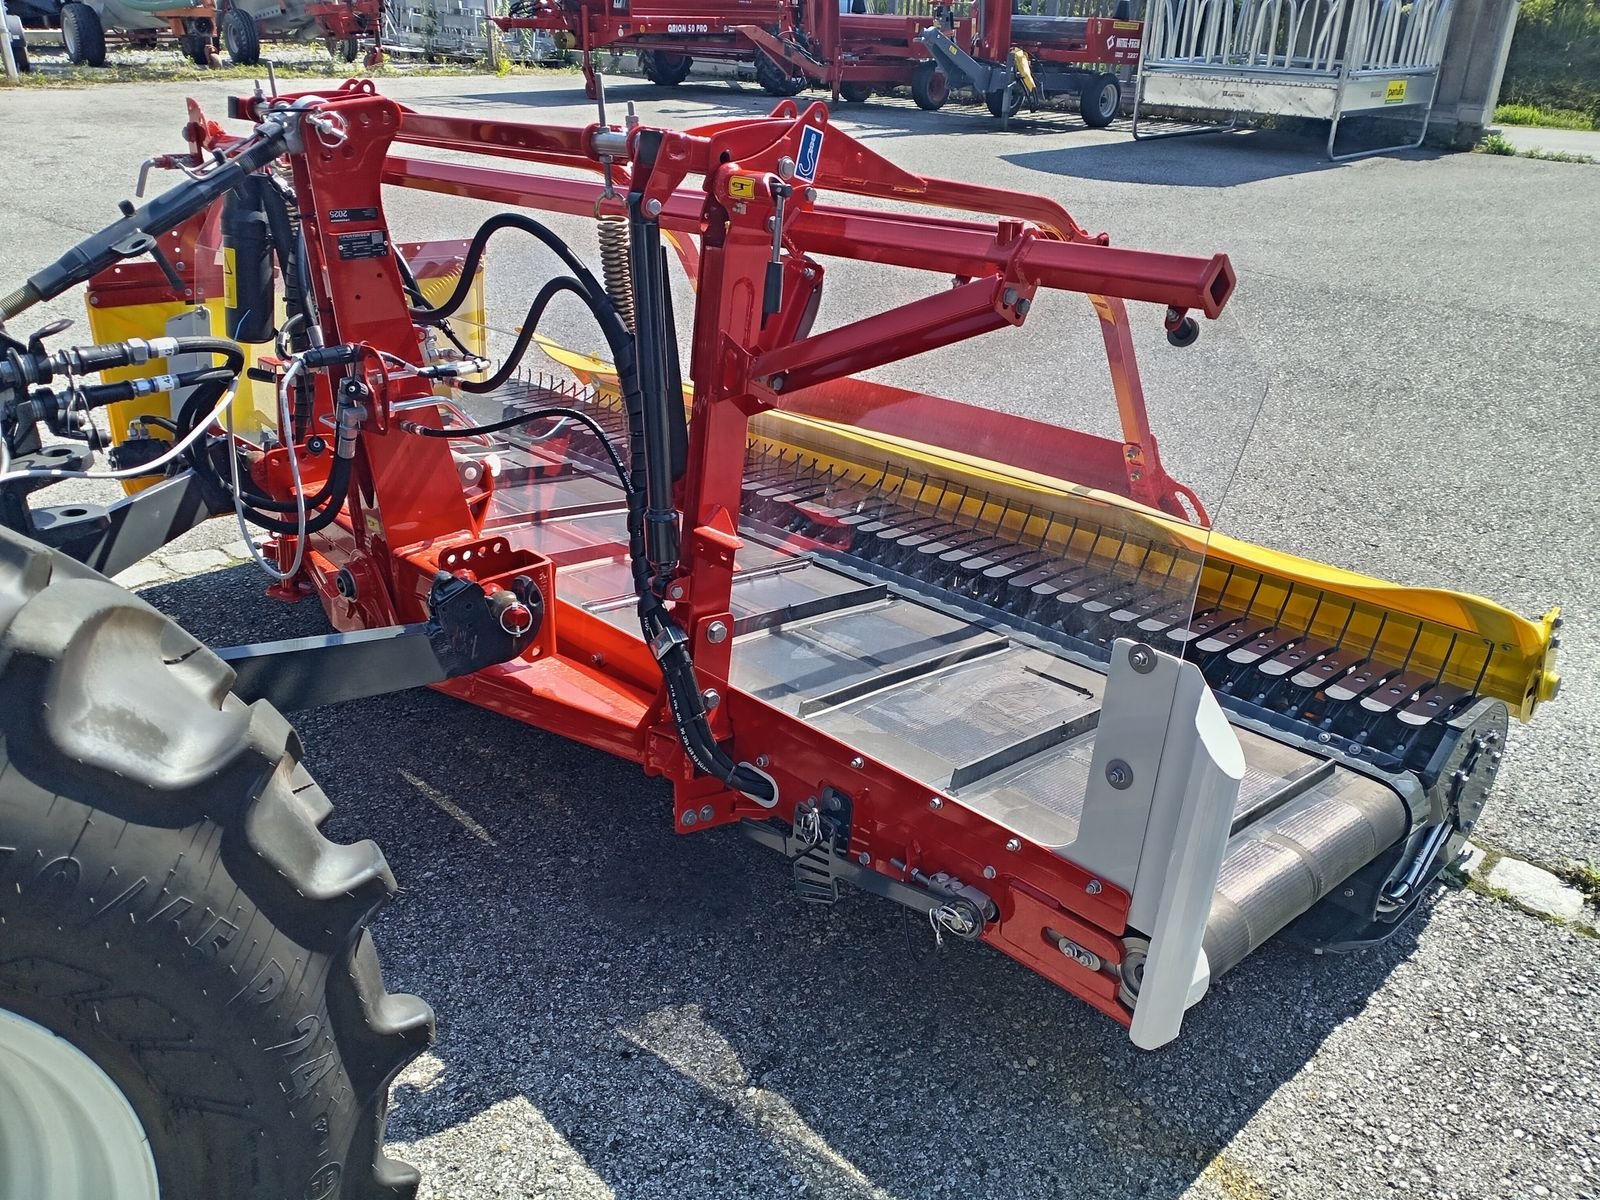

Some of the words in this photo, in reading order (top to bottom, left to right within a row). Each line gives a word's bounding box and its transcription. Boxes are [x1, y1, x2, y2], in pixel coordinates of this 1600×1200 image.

[667, 23, 687, 33] ORION
[688, 24, 696, 33] 50
[696, 24, 708, 33] PRO
[329, 210, 348, 219] 2025
